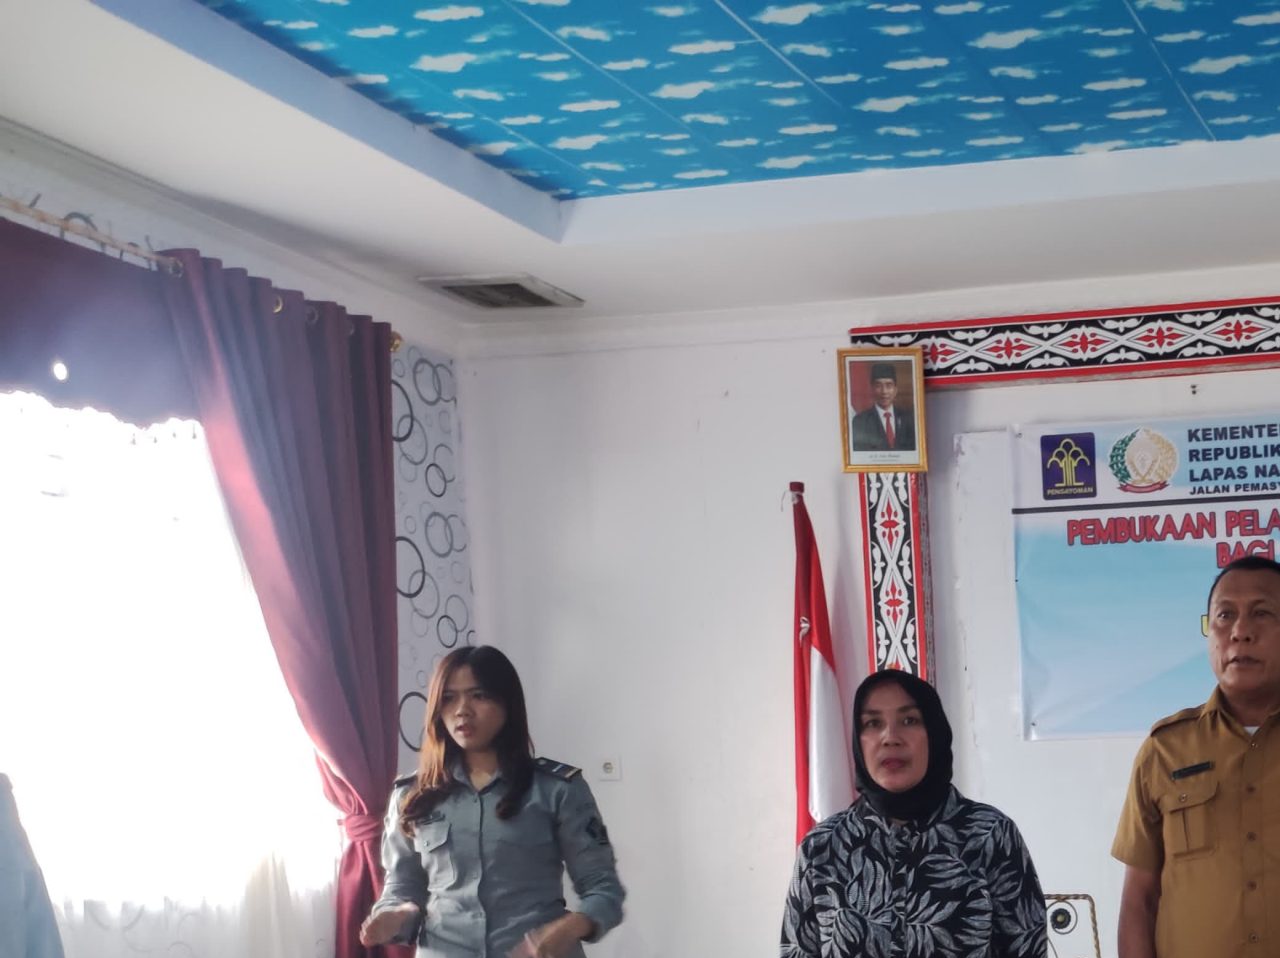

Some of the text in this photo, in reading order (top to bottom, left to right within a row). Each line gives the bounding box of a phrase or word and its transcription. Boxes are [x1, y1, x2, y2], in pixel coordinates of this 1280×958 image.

[1189, 465, 1248, 482] LAPAS
[1189, 484, 1230, 496] JALAN
[1067, 511, 1216, 546] PEMBUKAAN
[1216, 538, 1275, 569] BAGI
